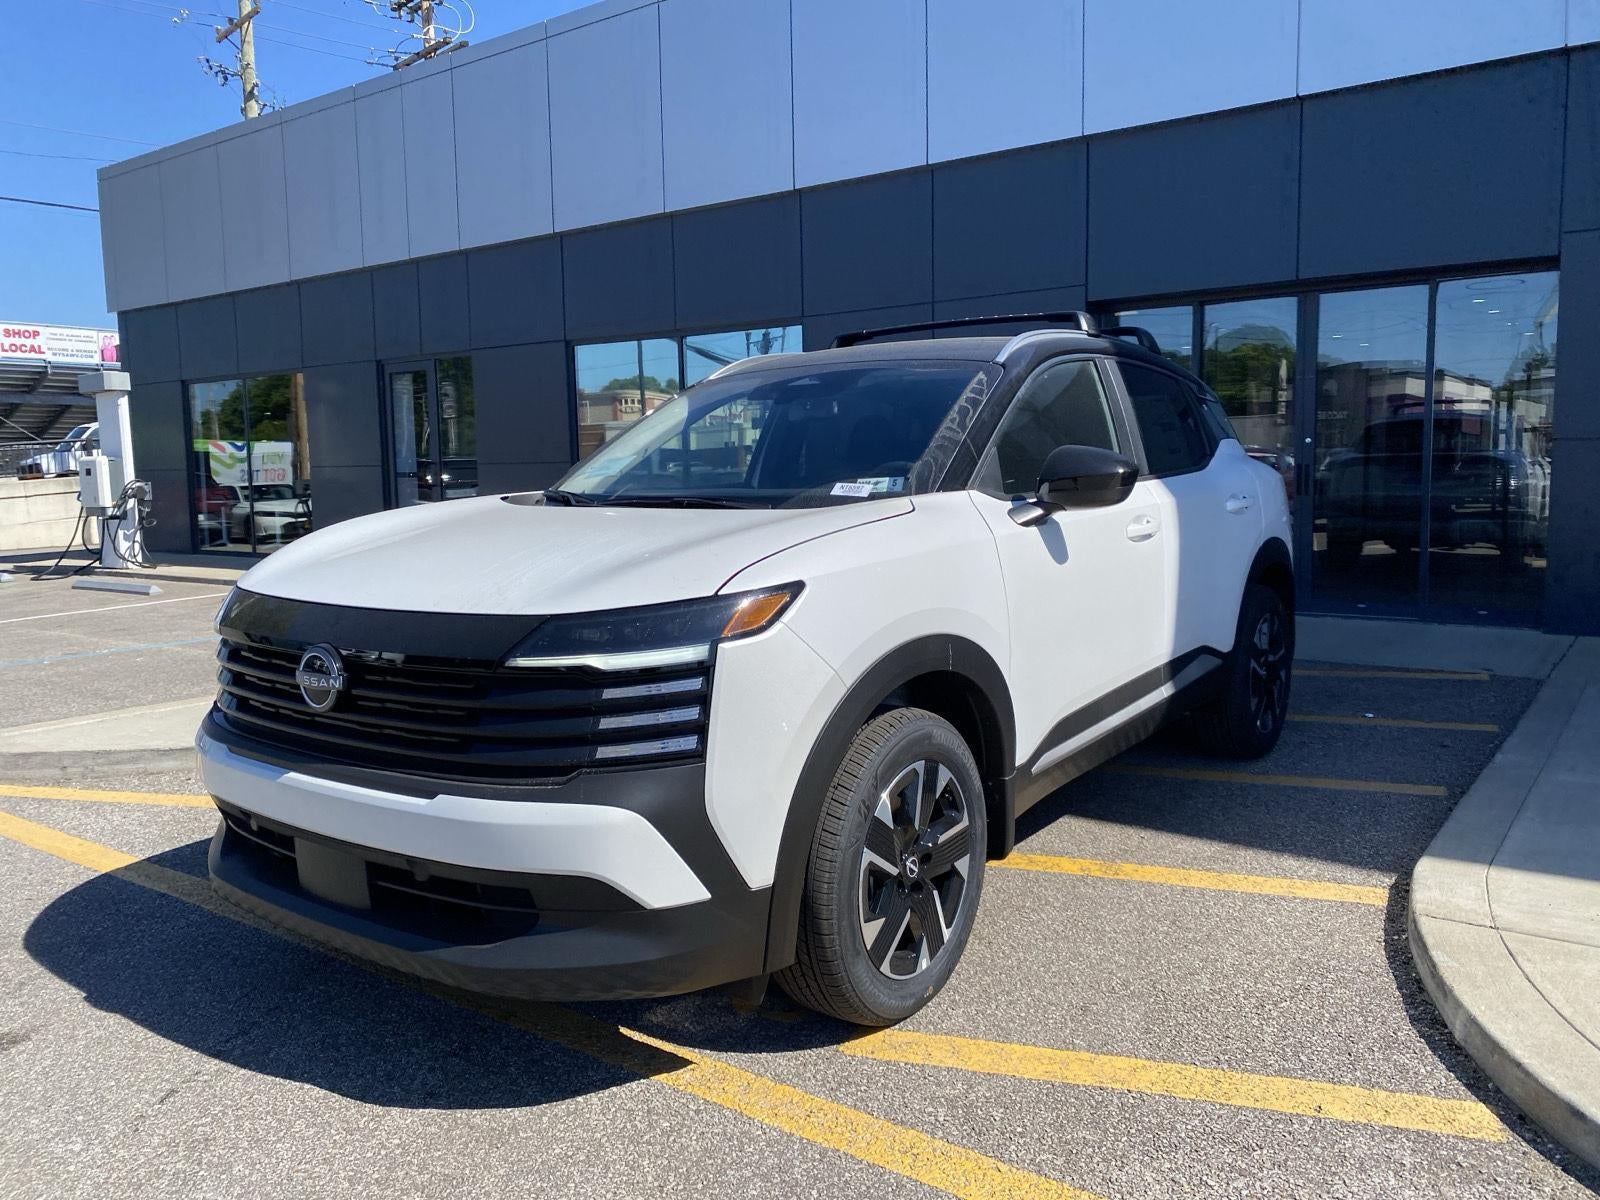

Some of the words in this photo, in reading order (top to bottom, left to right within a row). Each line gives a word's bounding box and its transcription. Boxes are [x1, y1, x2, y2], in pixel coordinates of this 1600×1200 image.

[3, 328, 40, 340] SHOP
[0, 343, 46, 355] LOCAL
[891, 478, 898, 487] 5
